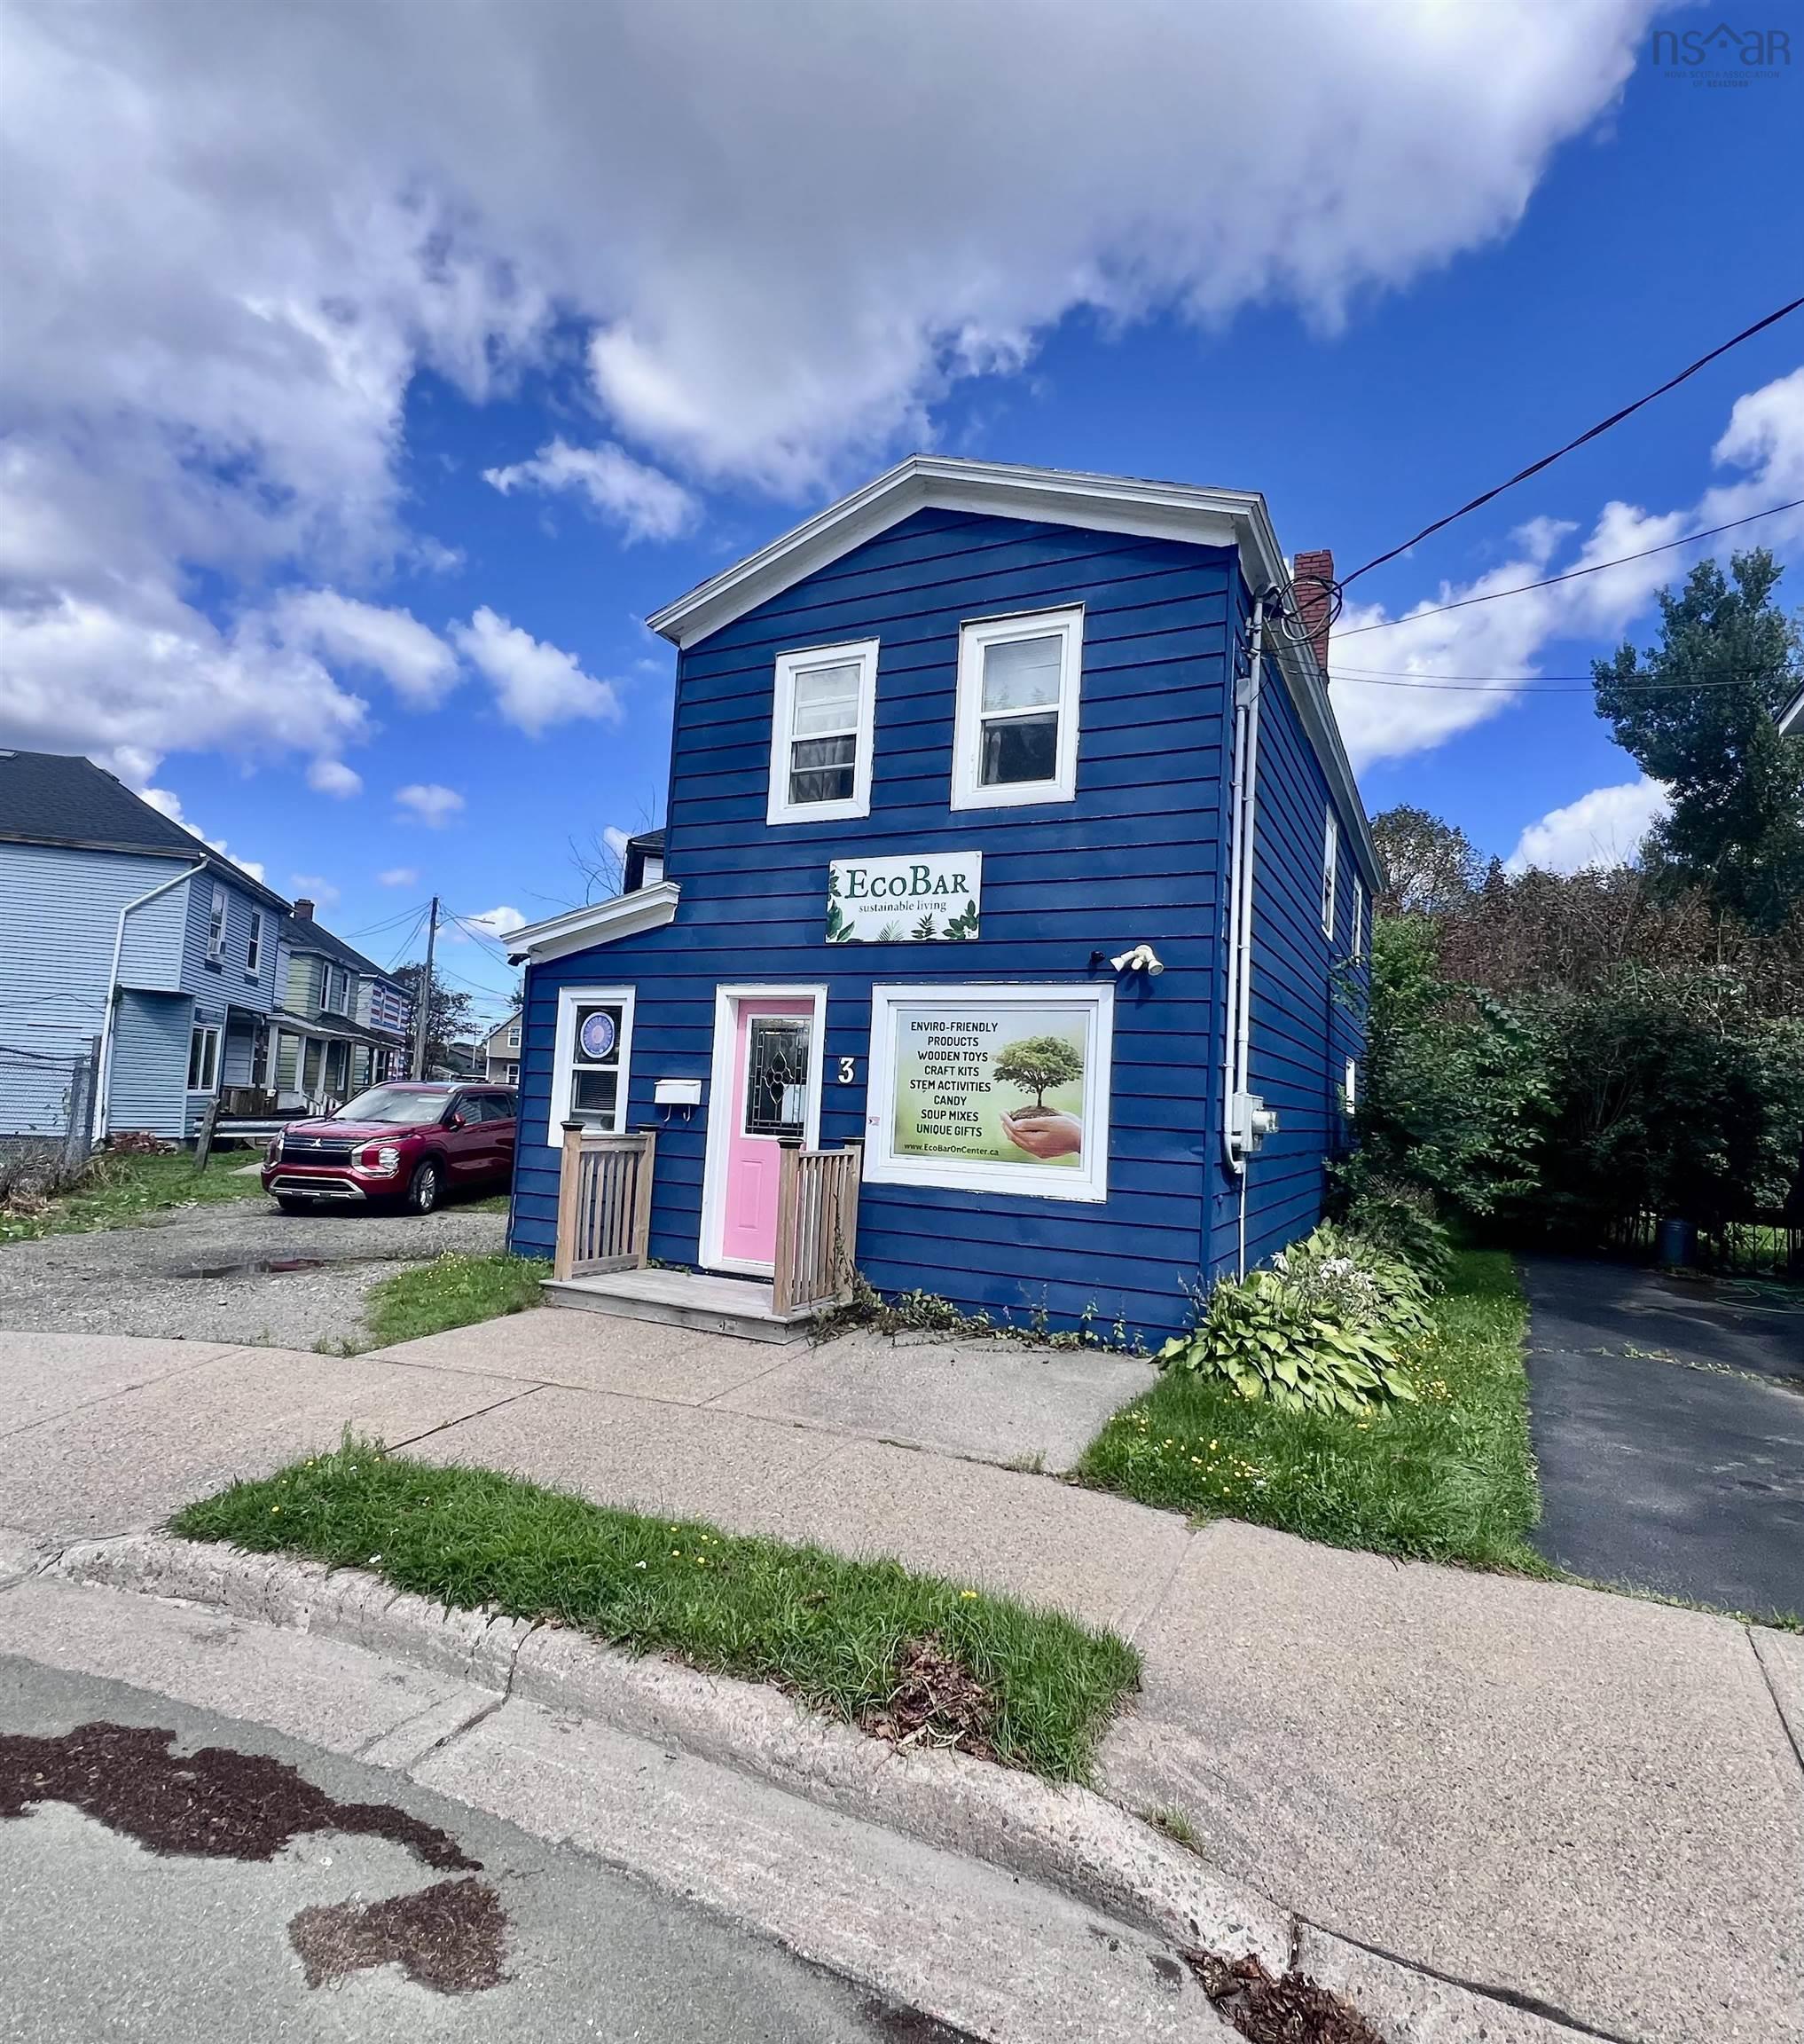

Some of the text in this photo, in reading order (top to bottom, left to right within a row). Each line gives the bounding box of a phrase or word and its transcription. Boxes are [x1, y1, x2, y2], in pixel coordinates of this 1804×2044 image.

[859, 900, 947, 913] sustainable living
[911, 1021, 999, 1033] ENVIRO-FRIENDLY
[928, 1036, 979, 1047] PRODUCTS
[918, 1050, 988, 1062] WOODEN TOYS
[837, 1057, 855, 1084] 3
[924, 1065, 979, 1077] CRAFT KITS
[910, 1080, 991, 1092] STEM ACTIVITIES
[934, 1095, 967, 1106] CANDY
[921, 1110, 978, 1122] SOUP MIXES
[916, 1124, 982, 1137] UNIQUE GIFTS
[904, 1144, 999, 1156] www.EcoBarOnCenter.ca
